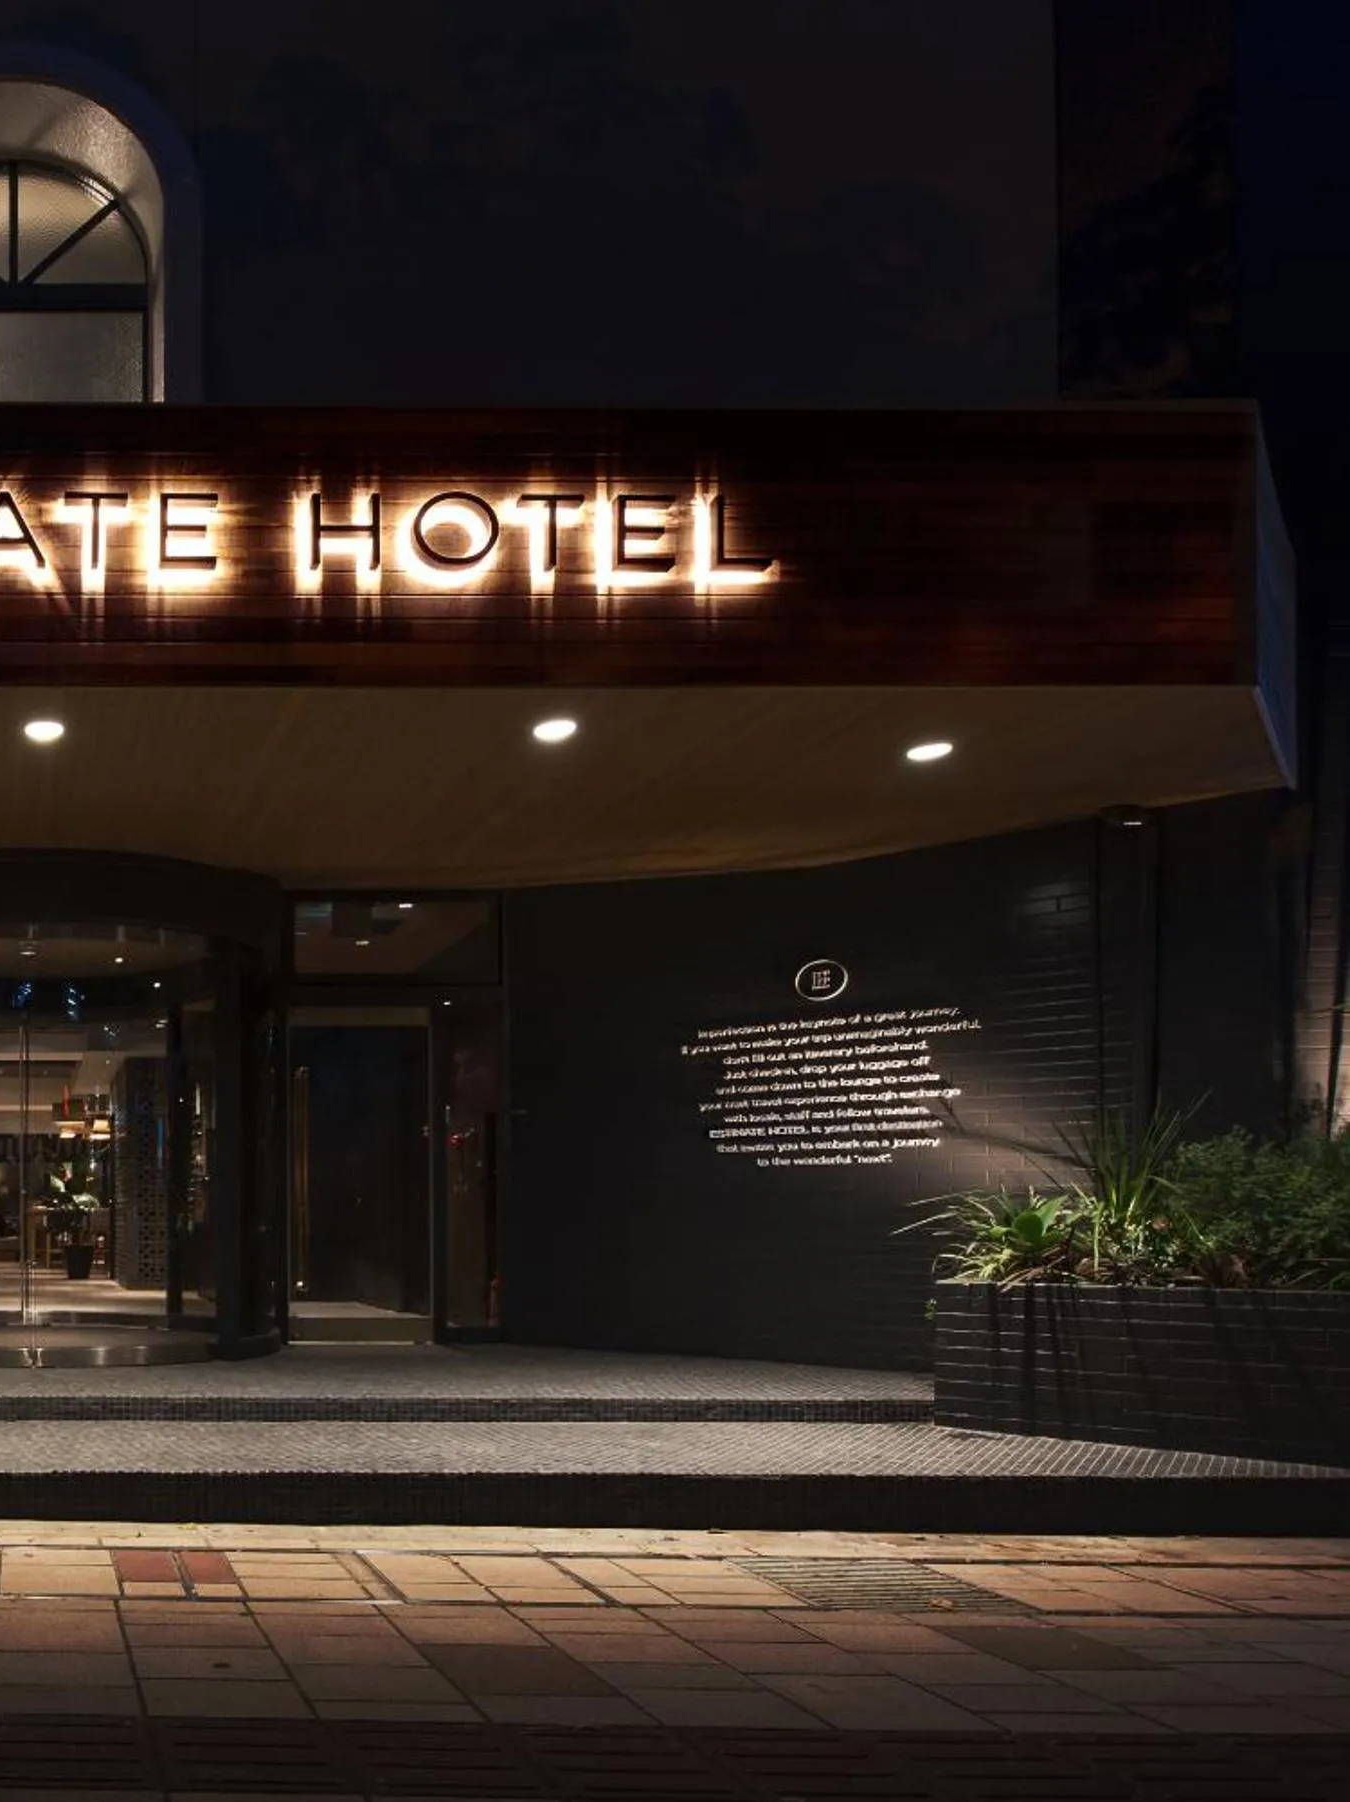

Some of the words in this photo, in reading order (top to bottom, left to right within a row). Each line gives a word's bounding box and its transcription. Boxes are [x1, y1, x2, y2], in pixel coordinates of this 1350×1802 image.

[308, 491, 778, 576] HOTEL
[874, 1011, 906, 1022] great
[784, 1036, 810, 1047] your
[799, 1065, 827, 1074] drop
[830, 1063, 856, 1074] your
[858, 1060, 909, 1071] luggage
[840, 1077, 882, 1087] lounge
[849, 1091, 898, 1102] through
